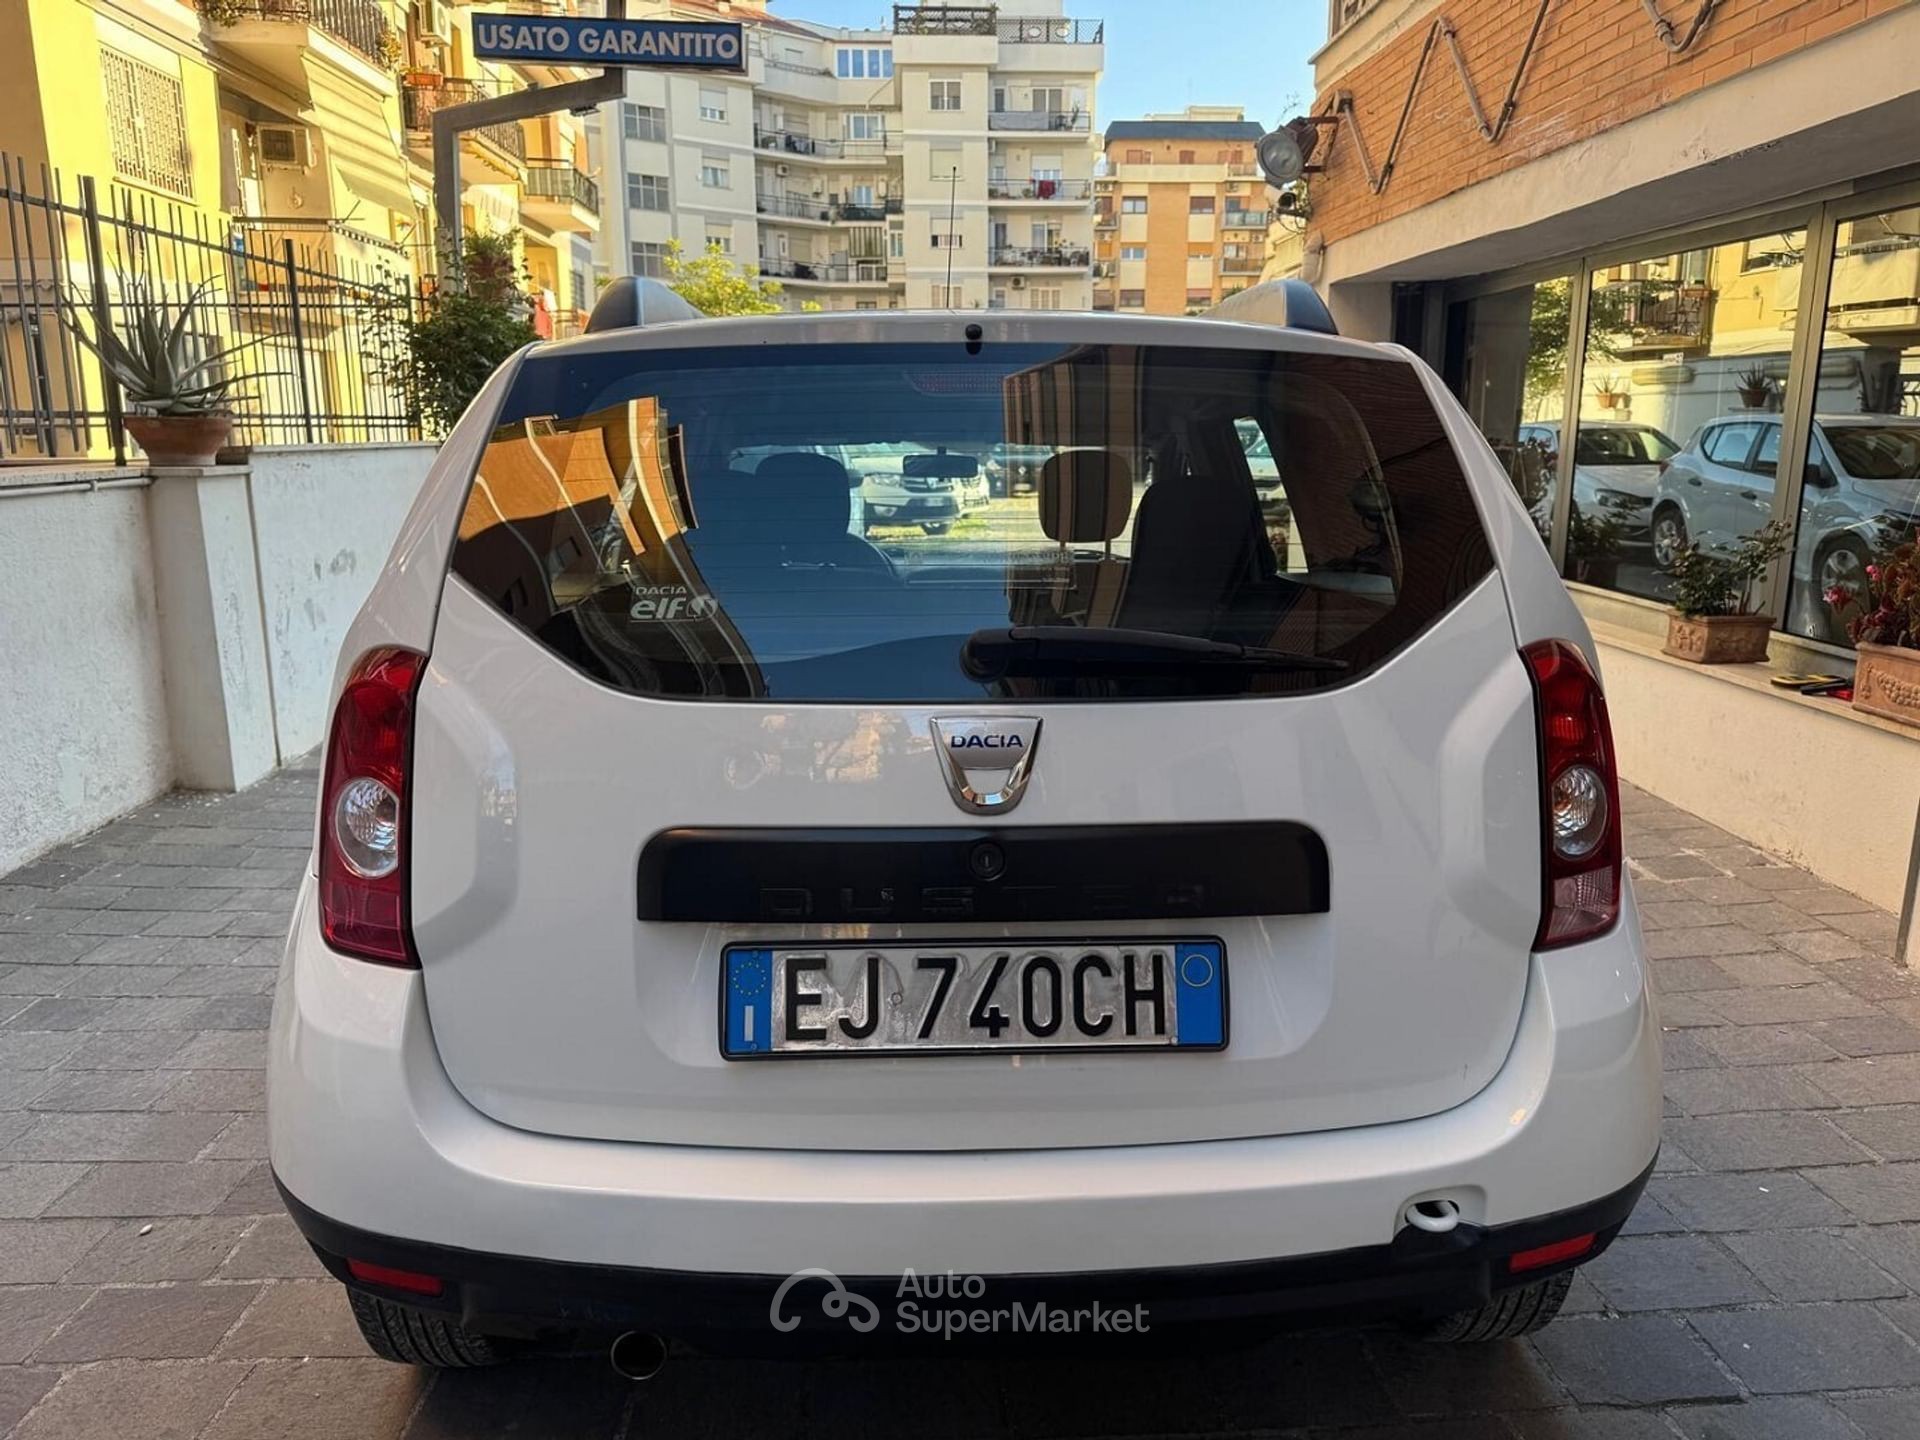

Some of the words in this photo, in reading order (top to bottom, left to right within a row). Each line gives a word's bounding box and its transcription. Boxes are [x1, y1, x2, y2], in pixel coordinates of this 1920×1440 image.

[478, 24, 570, 52] USATO
[578, 28, 739, 59] GARANTITO
[635, 586, 687, 595] DACIA
[630, 597, 687, 619] elf
[951, 734, 1023, 748] DACIA
[785, 957, 880, 1041] EJ
[916, 953, 1166, 1040] 740CH
